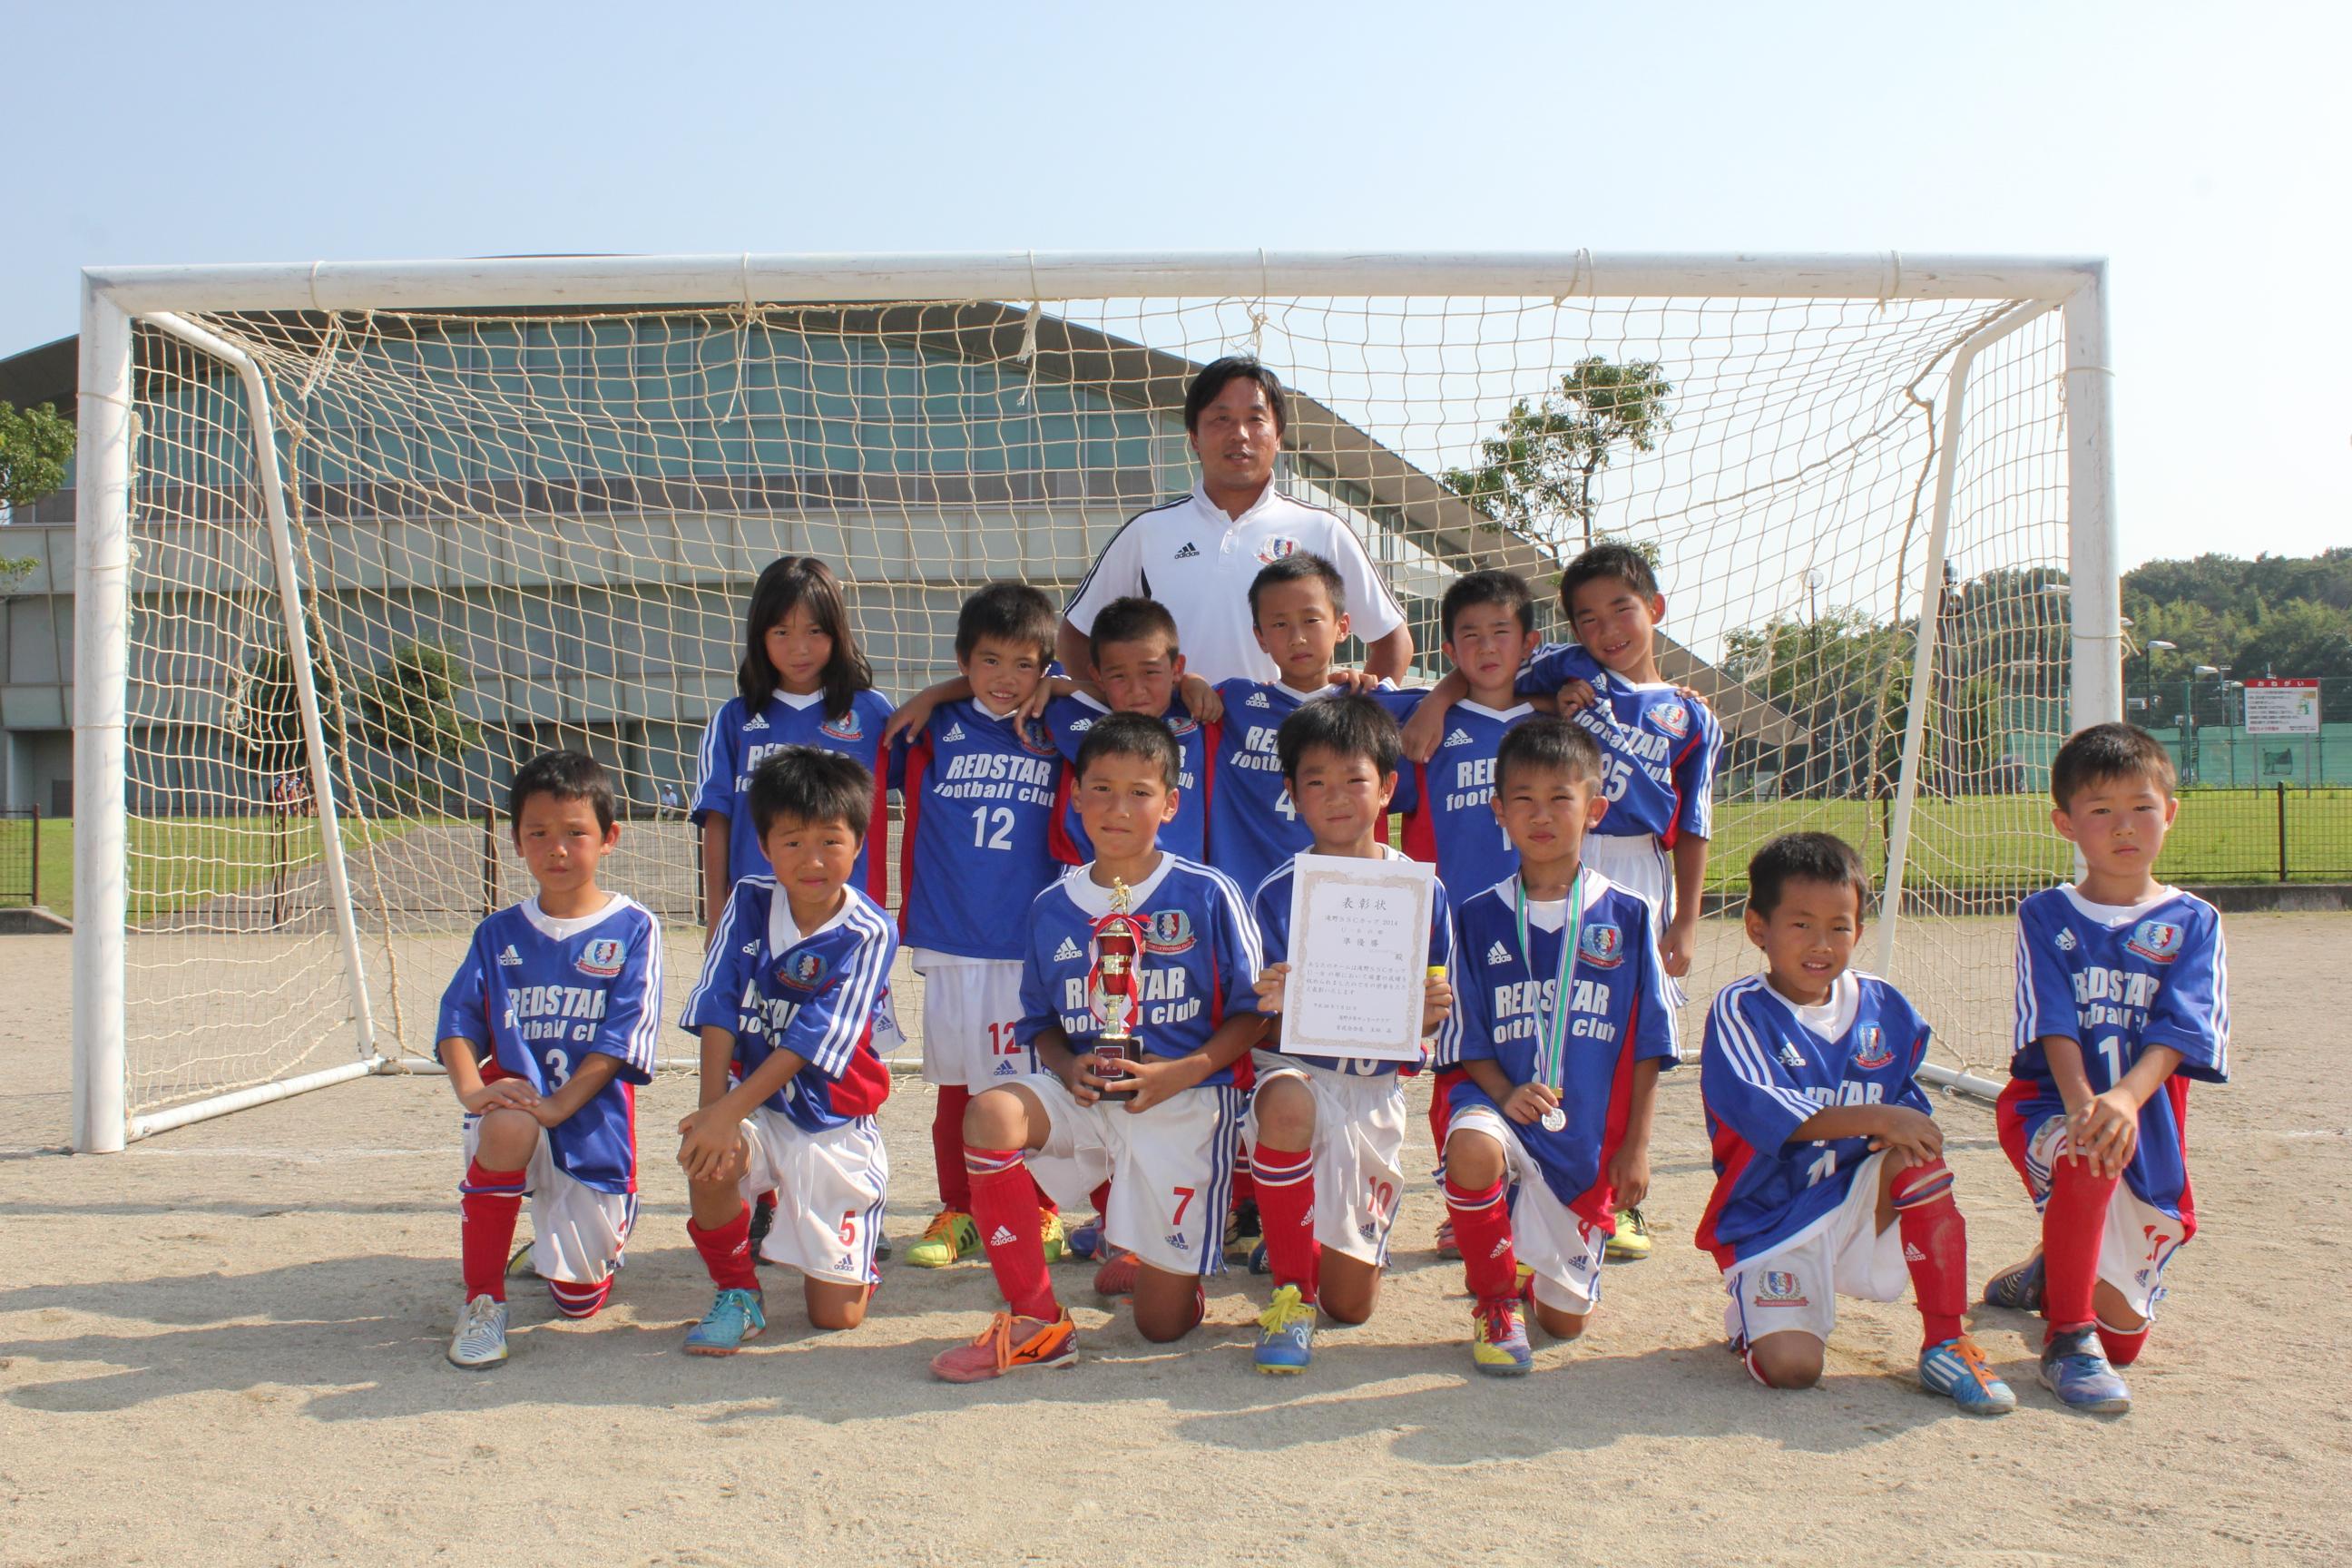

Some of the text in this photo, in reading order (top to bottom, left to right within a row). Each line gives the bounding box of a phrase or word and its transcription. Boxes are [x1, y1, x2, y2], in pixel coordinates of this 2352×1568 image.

[1174, 551, 1200, 560] adidas
[1246, 700, 1269, 709] adidas
[742, 722, 769, 732] adidas
[943, 734, 965, 742] adidas
[1444, 738, 1474, 747] adidas
[946, 753, 1052, 787] REDSTAR
[1230, 751, 1284, 771] footb
[933, 781, 1014, 799] football
[1446, 786, 1497, 811] foot
[1275, 789, 1296, 820] 4
[972, 806, 1014, 850] 12
[1342, 897, 1387, 911] 表彰状
[1054, 949, 1083, 962] adidas
[1488, 955, 1513, 965] didas
[1065, 966, 1186, 1010] RTAR
[1494, 979, 1610, 1019] REDSAR
[2072, 966, 2161, 1009] RDSTAR
[1152, 997, 1201, 1024] club
[504, 1009, 598, 1042] ftball cl
[988, 1022, 1021, 1054] 12
[545, 1048, 571, 1093] 3
[2099, 1035, 2132, 1090] 1
[1172, 1187, 1195, 1225] 7
[1366, 1175, 1394, 1218] 10
[838, 1210, 856, 1247] 5
[990, 1234, 1016, 1247] adidas
[834, 1263, 854, 1271] adidas
